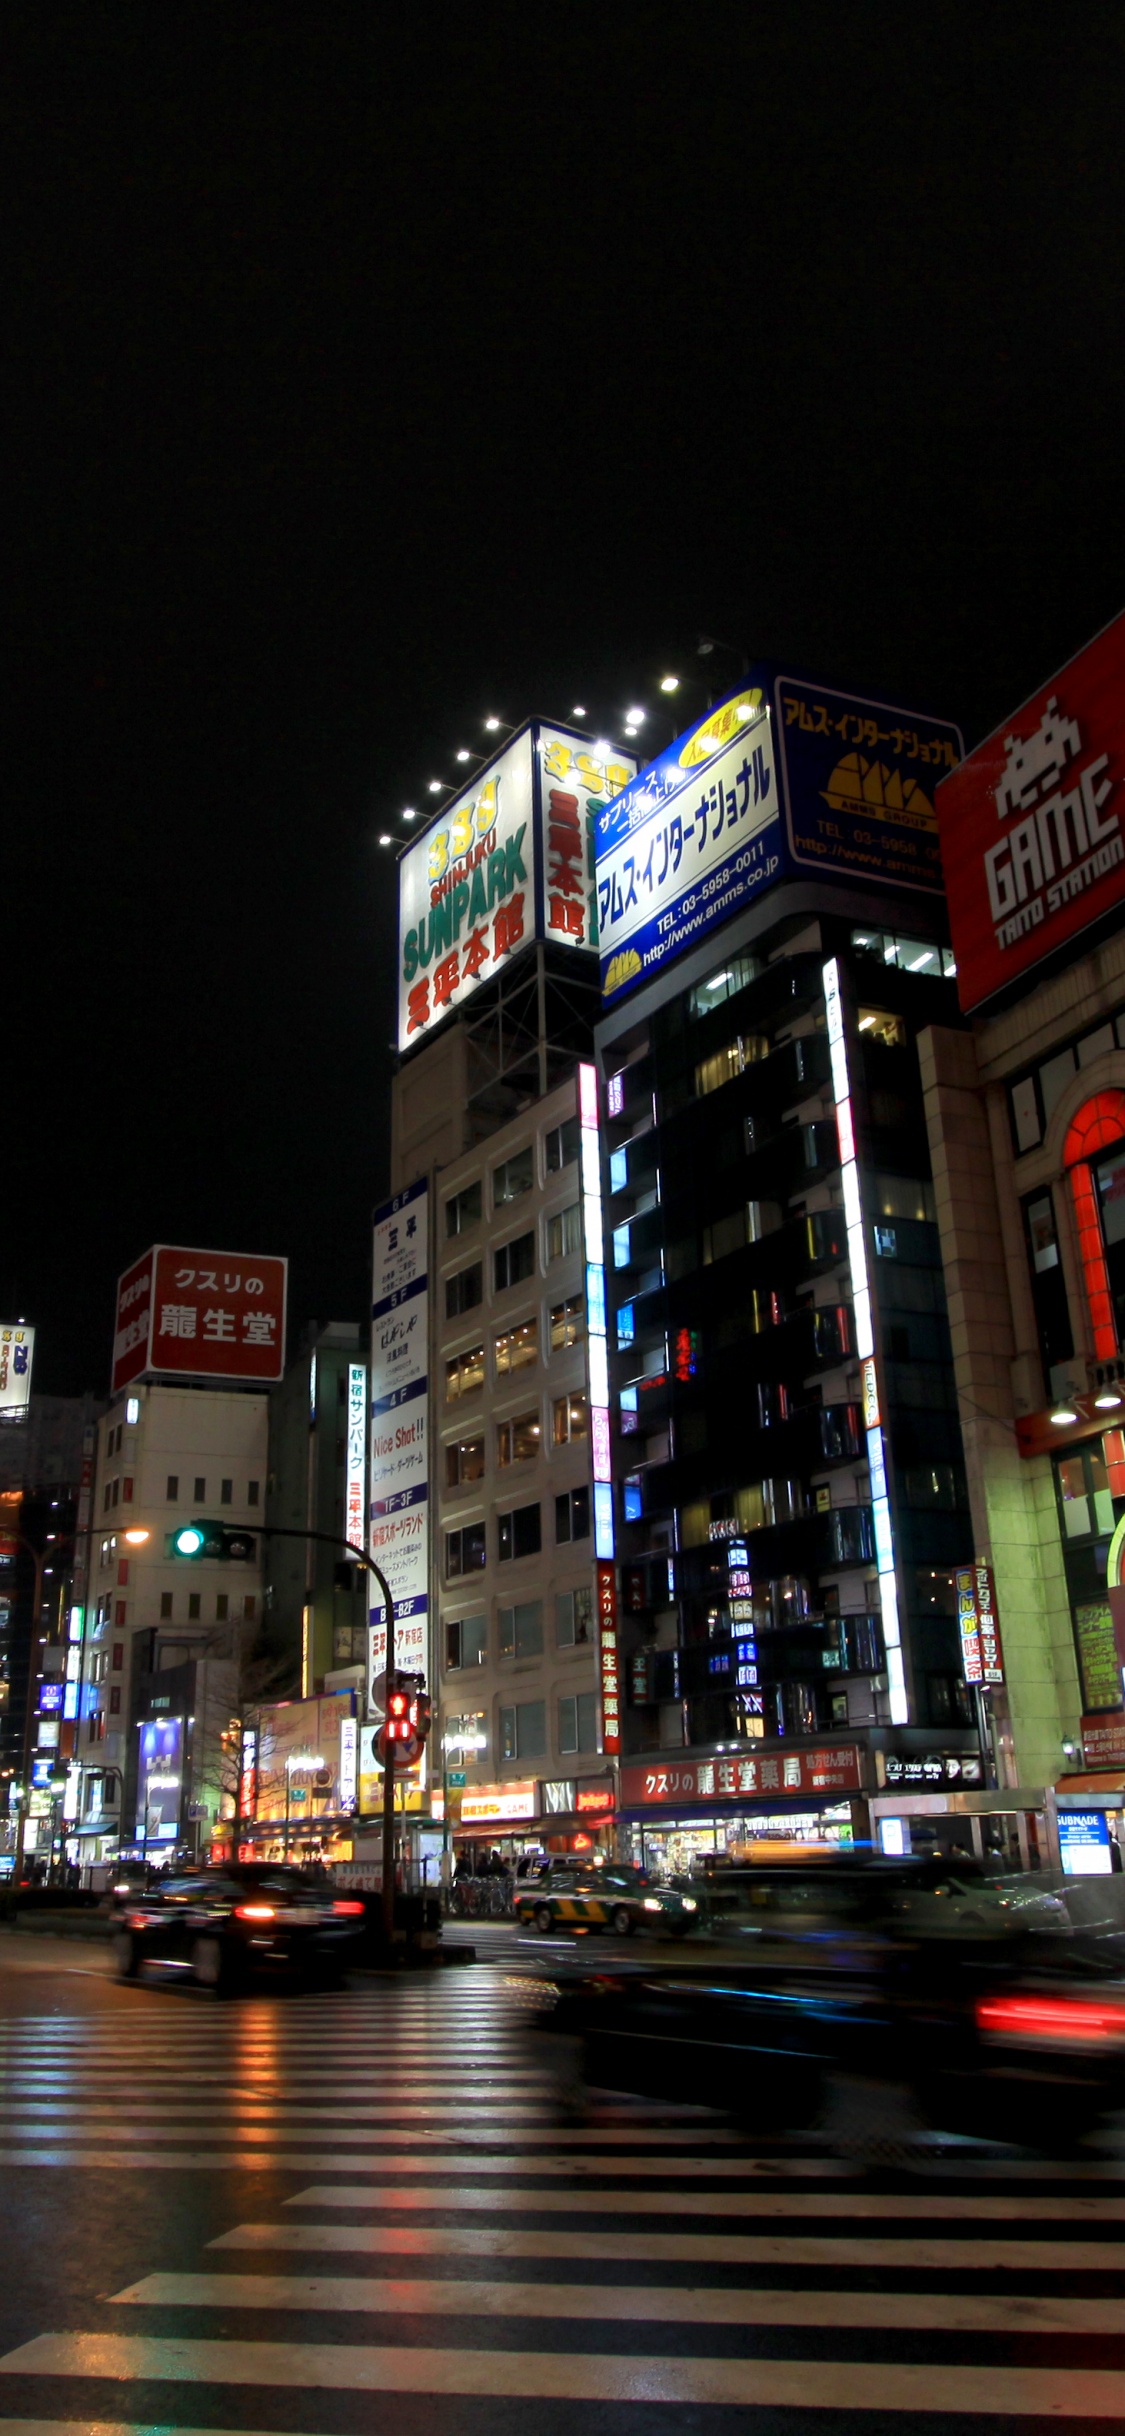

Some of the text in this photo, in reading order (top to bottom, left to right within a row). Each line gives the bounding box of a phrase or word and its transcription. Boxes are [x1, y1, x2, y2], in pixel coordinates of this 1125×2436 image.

[784, 697, 958, 769] アムス・インターナショナル
[597, 745, 771, 934] アムス・インターナショナル
[883, 810, 928, 828] GROUP
[984, 752, 1120, 923] GAME
[403, 822, 528, 982] SUNPARK
[430, 827, 497, 907] SHINJUKU
[995, 834, 1125, 950] TAITO STATION
[643, 855, 779, 967] http://www.amms.co.jp
[407, 893, 525, 1035] 三平本館
[174, 1268, 264, 1295] クスリの
[158, 1303, 276, 1346] 龍生堂
[390, 1387, 407, 1406] 4F
[374, 1435, 394, 1459] Nice
[372, 1512, 424, 1548] 新宿スポーツランド
[957, 1573, 981, 1680] まんが喫茶
[806, 1751, 854, 1770] 処方せん受付
[1057, 1815, 1099, 1827] SUBNADE
